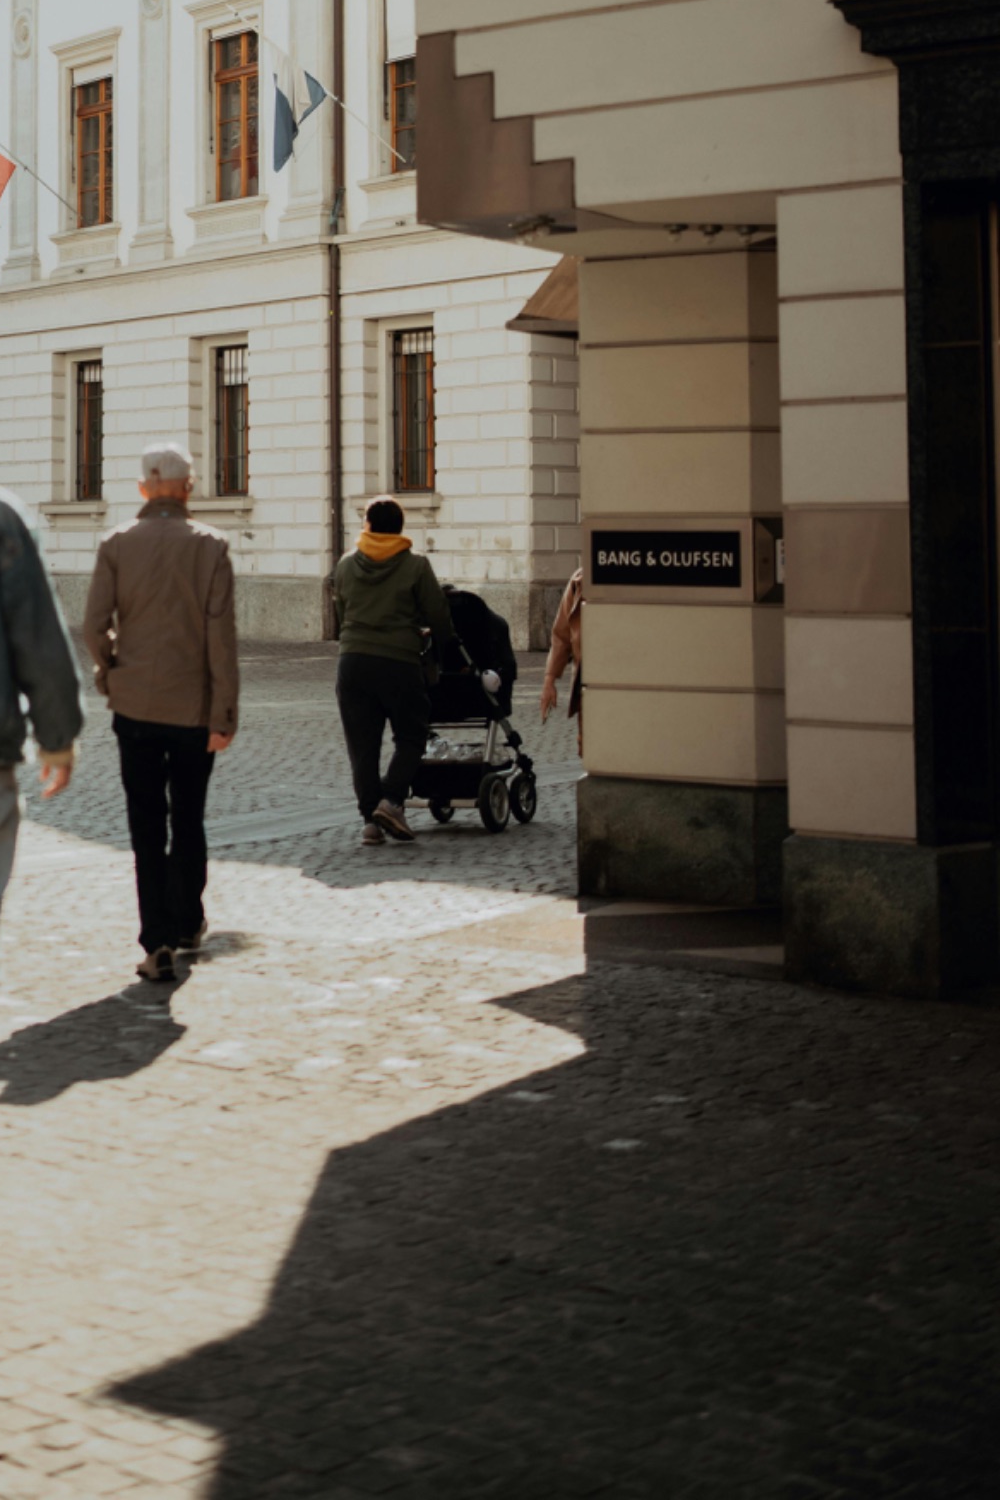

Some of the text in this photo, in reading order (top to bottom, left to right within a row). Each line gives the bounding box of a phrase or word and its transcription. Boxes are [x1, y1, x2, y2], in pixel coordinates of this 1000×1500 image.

[597, 550, 734, 567] BANG & OLUFSEN
